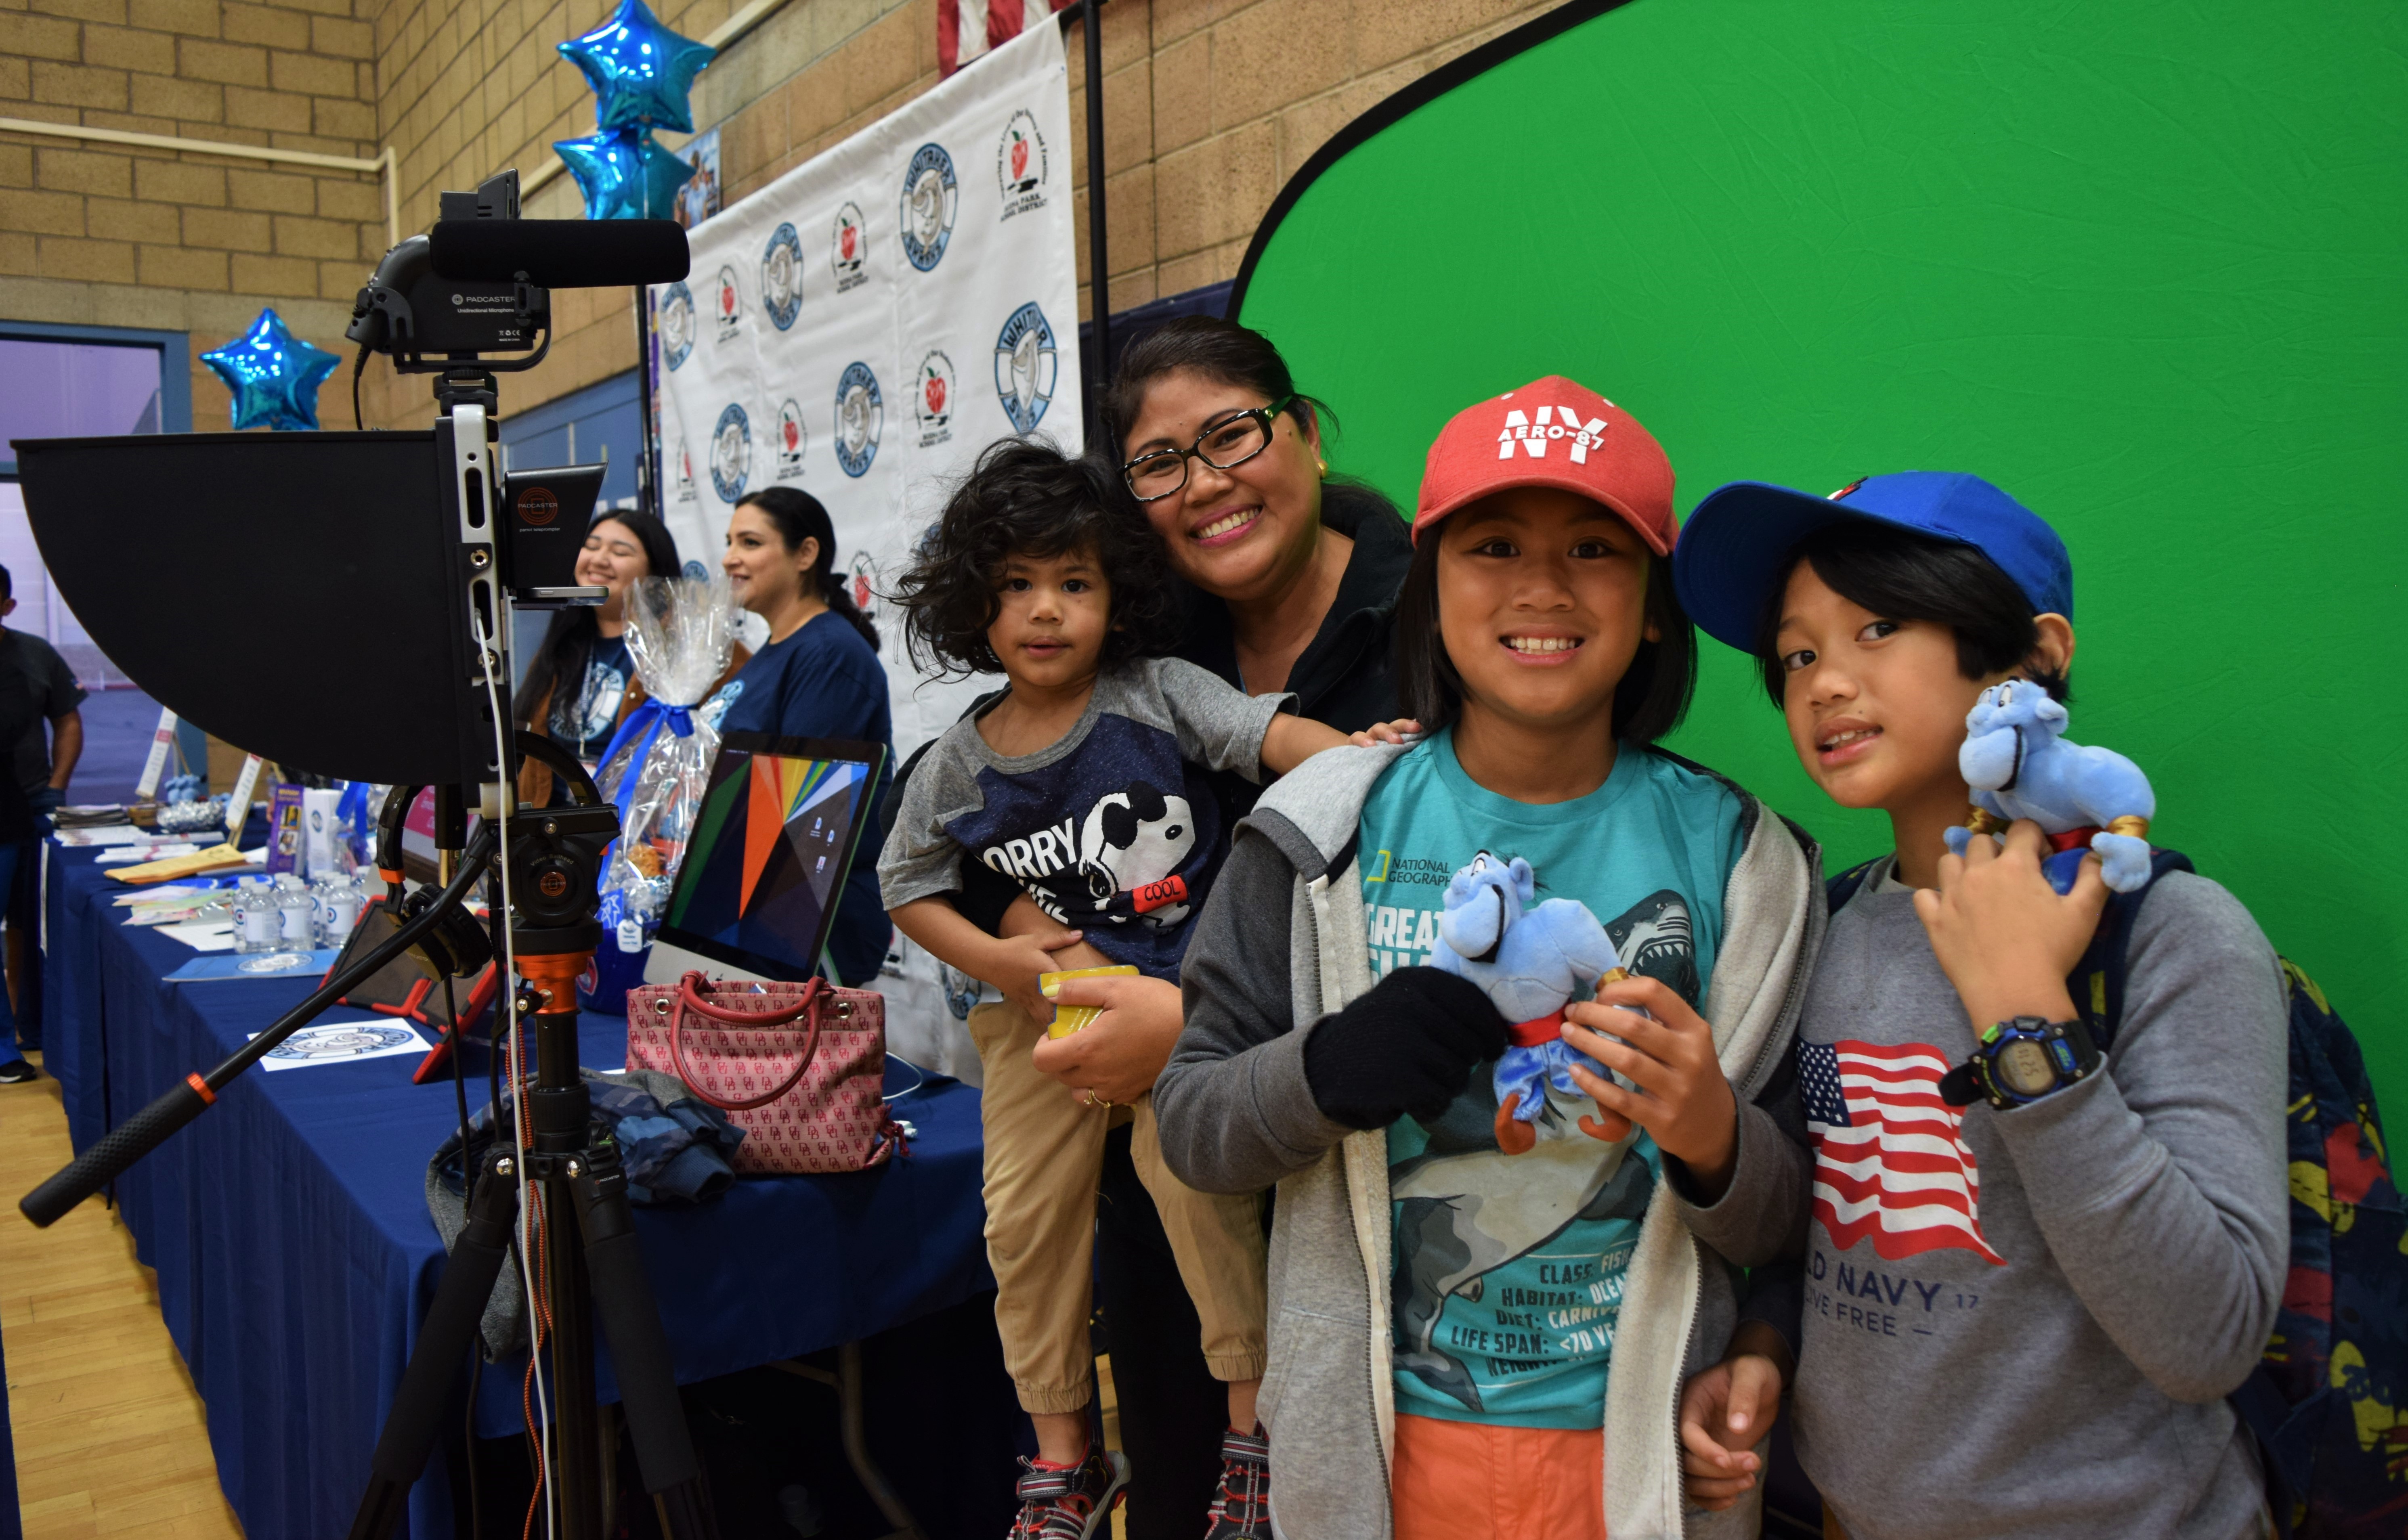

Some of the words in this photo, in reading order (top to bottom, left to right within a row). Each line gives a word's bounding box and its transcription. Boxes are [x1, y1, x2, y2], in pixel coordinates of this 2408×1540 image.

[906, 149, 951, 191] WHITAKER
[1021, 192, 1041, 203] PARK
[1497, 425, 1605, 451] AERO-87
[530, 856, 546, 866] Video
[549, 854, 575, 865] Ballhead
[983, 817, 1078, 878] ORRY
[1392, 857, 1451, 874] NATIONAL
[1144, 880, 1181, 901] COOL
[1388, 871, 1453, 887] GEOGRAPH
[599, 1174, 620, 1183] PADCASTER
[1501, 1288, 1583, 1307] HABITAT:
[1589, 1272, 1627, 1305] OCEA
[1837, 1261, 1942, 1312] NAVY
[1956, 1293, 1978, 1309] 17
[1495, 1309, 1542, 1331] DIET:
[1548, 1305, 1619, 1329] CARNIV
[1837, 1302, 1896, 1336] FREE
[1451, 1325, 1489, 1351] LIFE
[1494, 1332, 1550, 1355] SPAN:
[1559, 1330, 1594, 1354] <70
